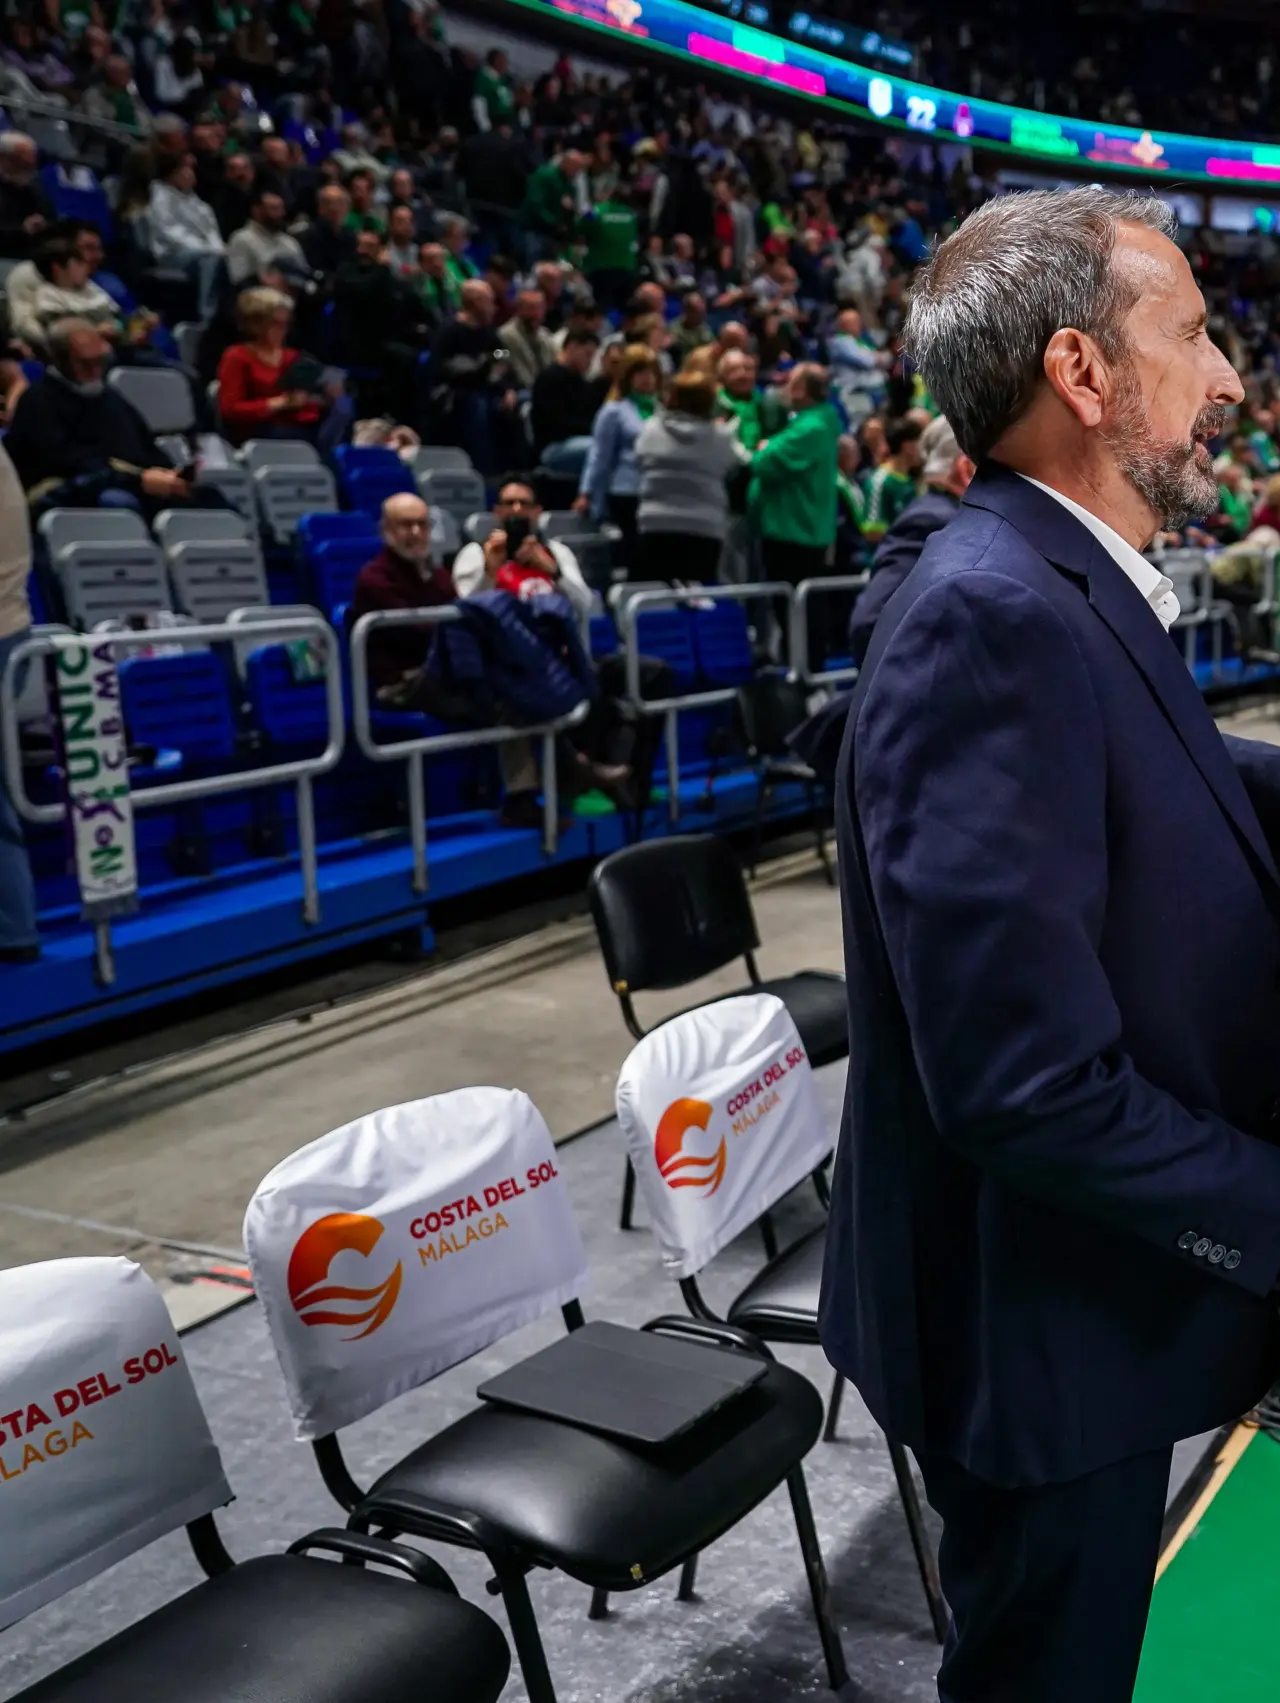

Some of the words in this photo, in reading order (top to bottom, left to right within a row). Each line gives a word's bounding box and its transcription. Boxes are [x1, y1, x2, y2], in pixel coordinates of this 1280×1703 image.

[906, 95, 937, 131] 22
[727, 1080, 763, 1116] COSTA
[763, 1063, 787, 1087] DEL
[410, 1195, 482, 1239] COSTA
[483, 1177, 526, 1208] DEL
[526, 1159, 558, 1188] SOL
[417, 1211, 509, 1267] MÁLAGA
[53, 1372, 122, 1418] DEL
[123, 1342, 178, 1384] SOL
